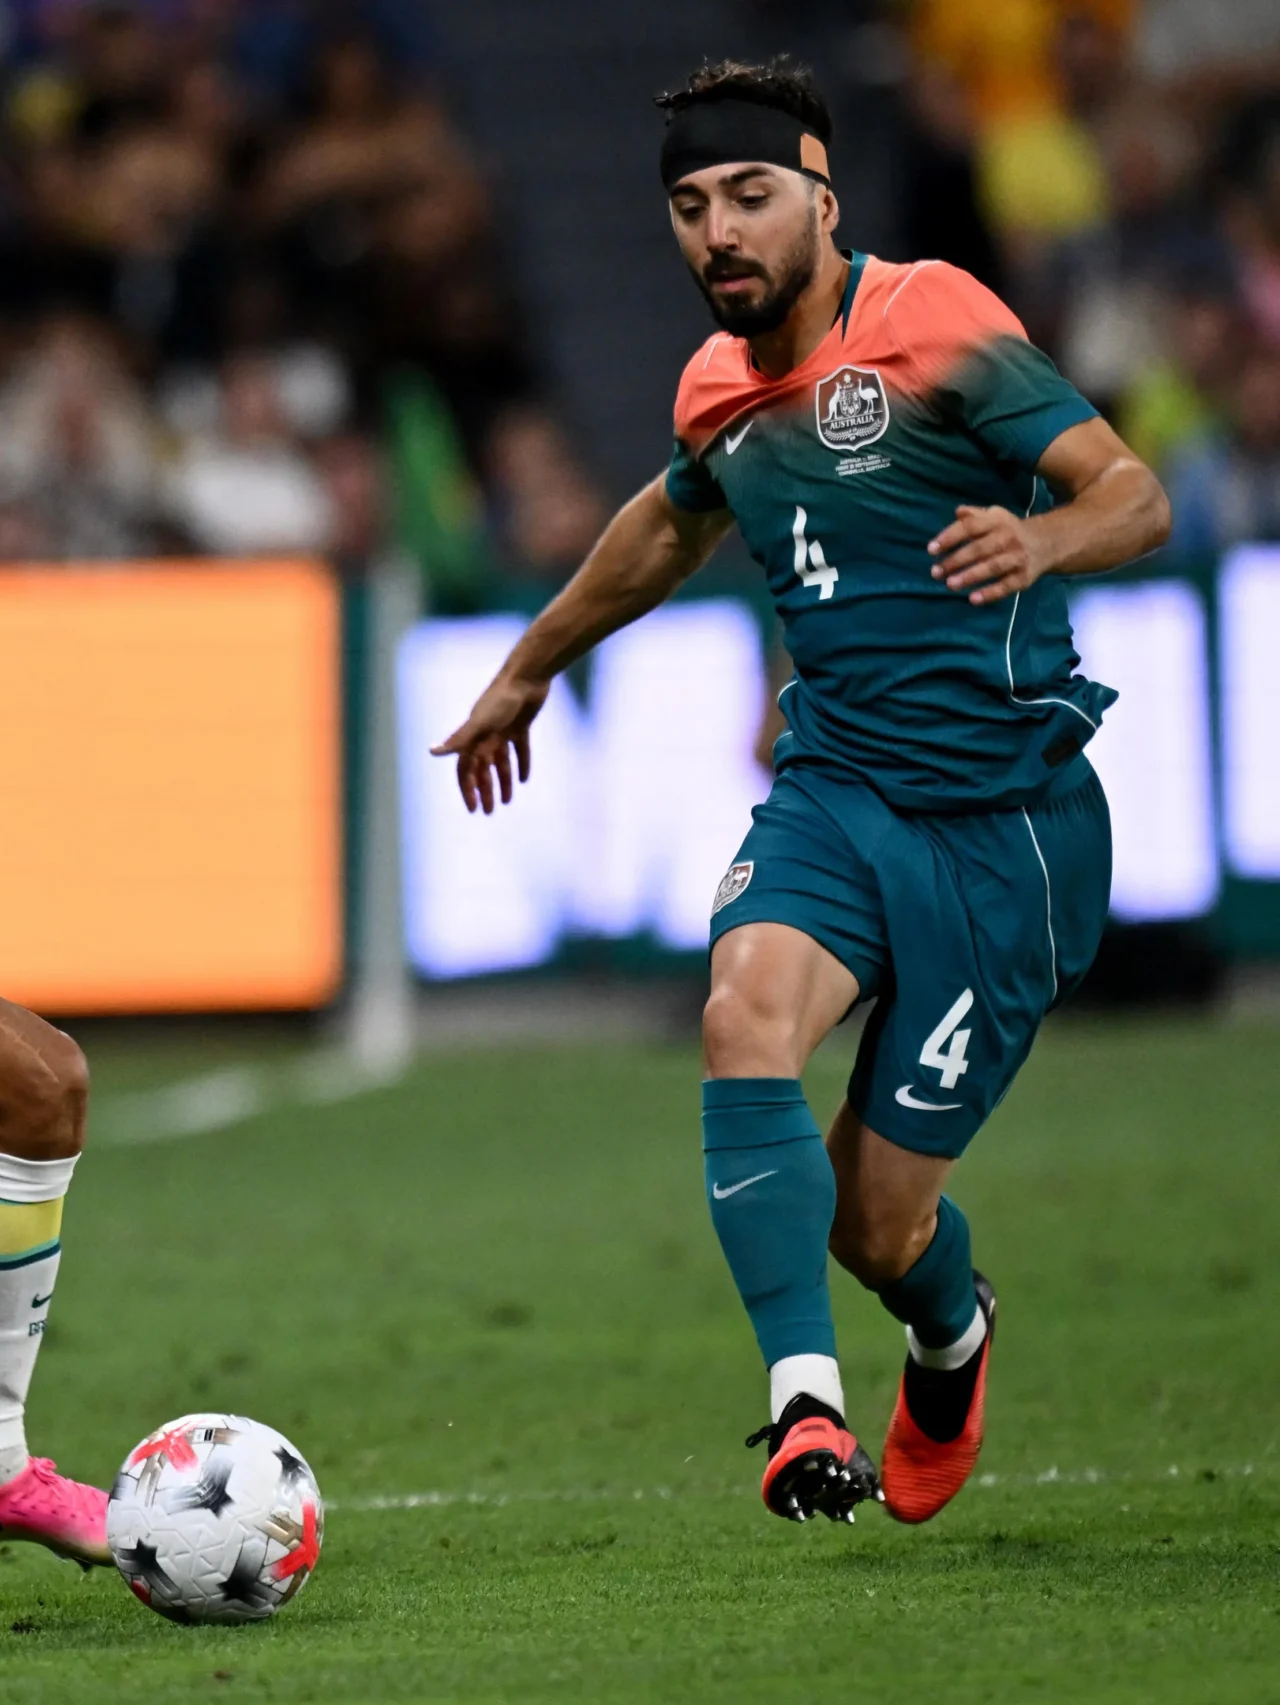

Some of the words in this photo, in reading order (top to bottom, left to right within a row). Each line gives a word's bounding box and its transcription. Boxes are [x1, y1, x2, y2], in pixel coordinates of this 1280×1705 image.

[830, 415, 874, 430] AUSTRALIA
[792, 505, 839, 600] 4
[919, 986, 975, 1090] 4
